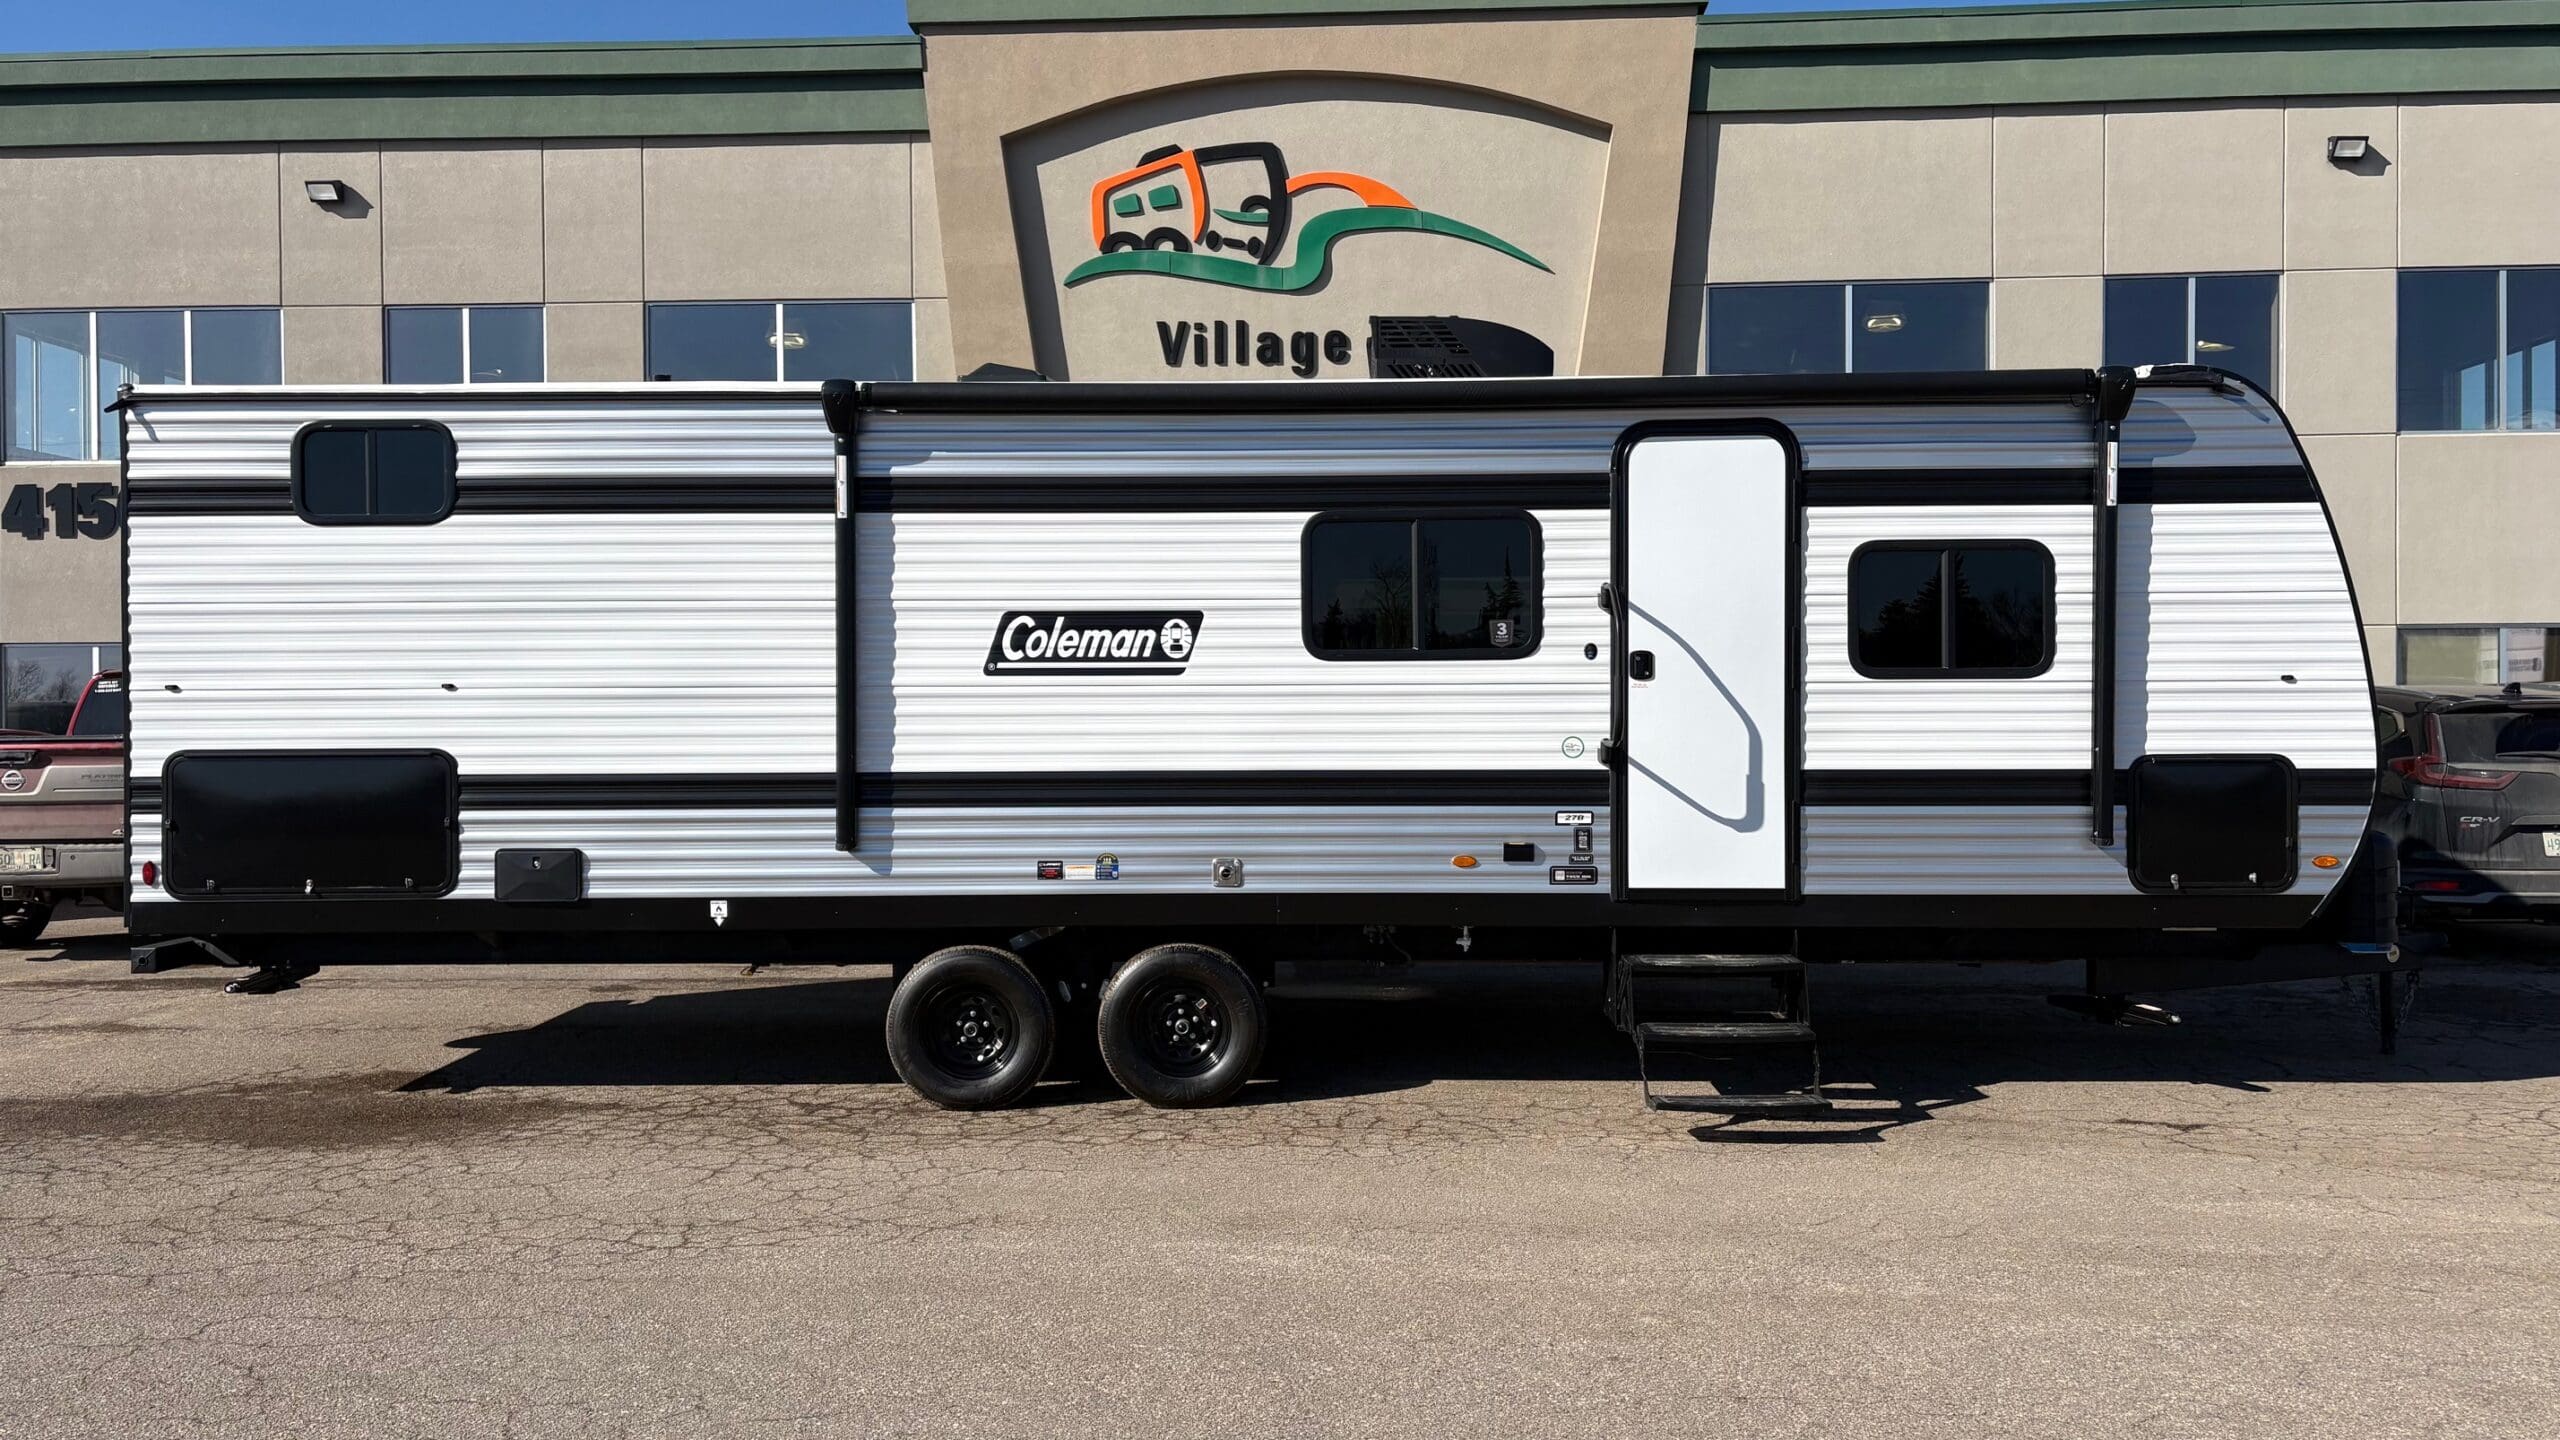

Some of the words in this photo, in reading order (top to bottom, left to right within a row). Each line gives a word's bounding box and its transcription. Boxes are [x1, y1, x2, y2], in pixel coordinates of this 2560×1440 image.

[1156, 320, 1352, 379] Village
[1002, 615, 1157, 661] Coleman
[1496, 622, 1507, 635] 3
